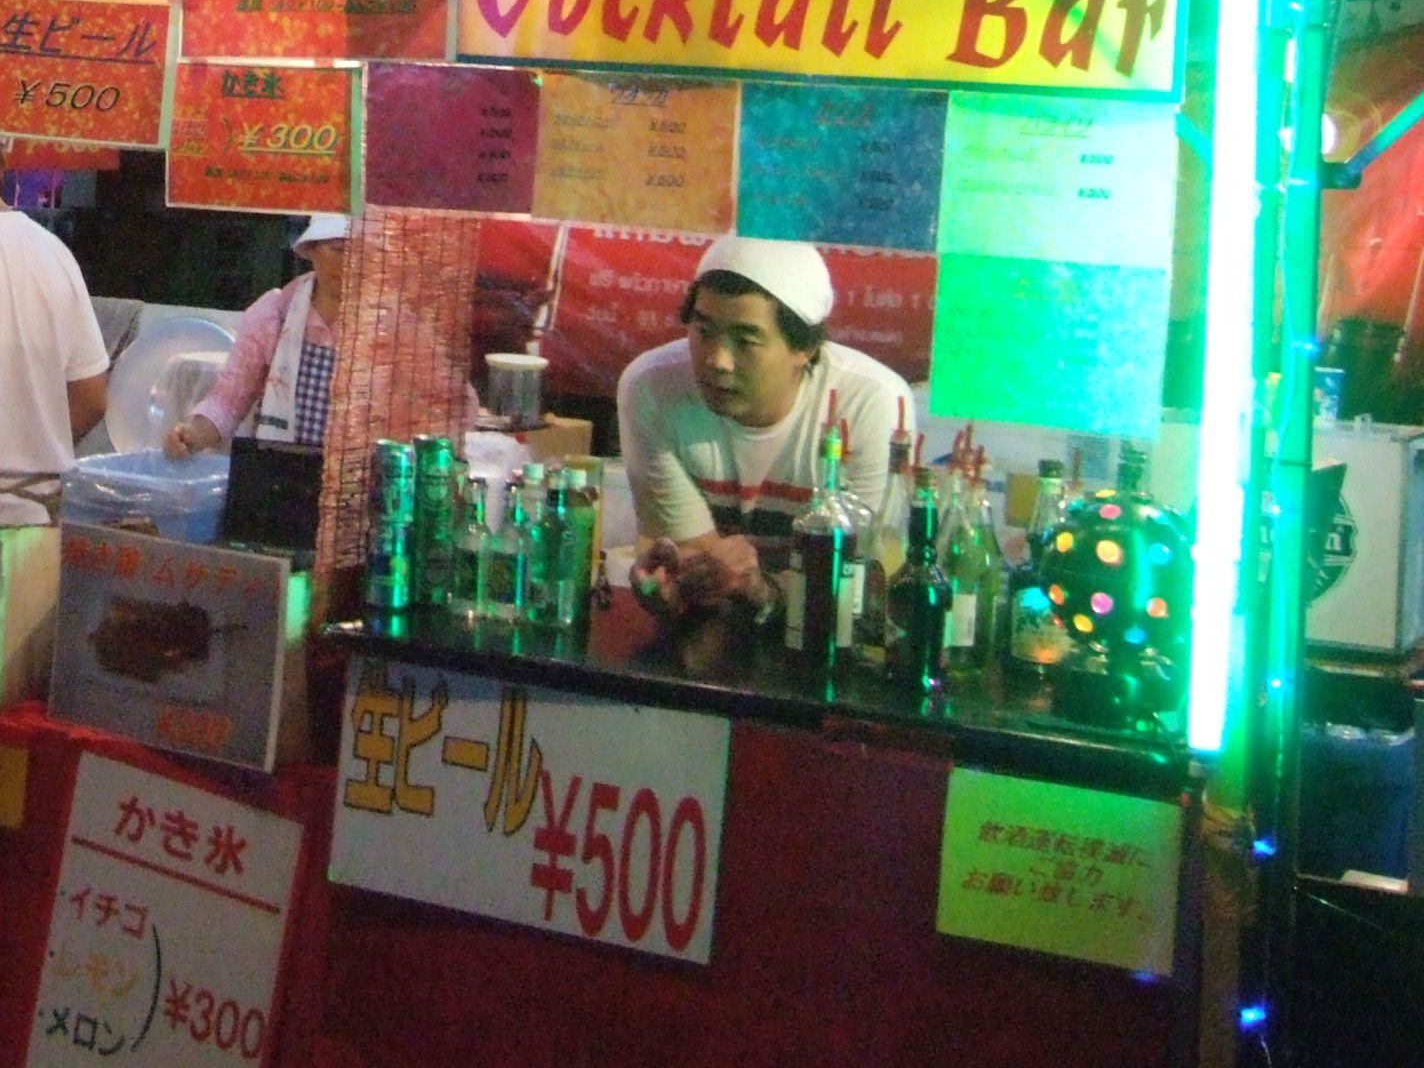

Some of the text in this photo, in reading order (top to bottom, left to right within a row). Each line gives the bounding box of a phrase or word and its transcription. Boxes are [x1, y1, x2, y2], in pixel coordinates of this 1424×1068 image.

[15, 79, 121, 112] ¥500
[243, 121, 338, 150] ¥300
[342, 662, 544, 837] 生ビール
[114, 796, 248, 875] かき氷
[530, 769, 707, 954] ¥500
[45, 1007, 125, 1057] メロン
[162, 979, 265, 1059] ¥300
